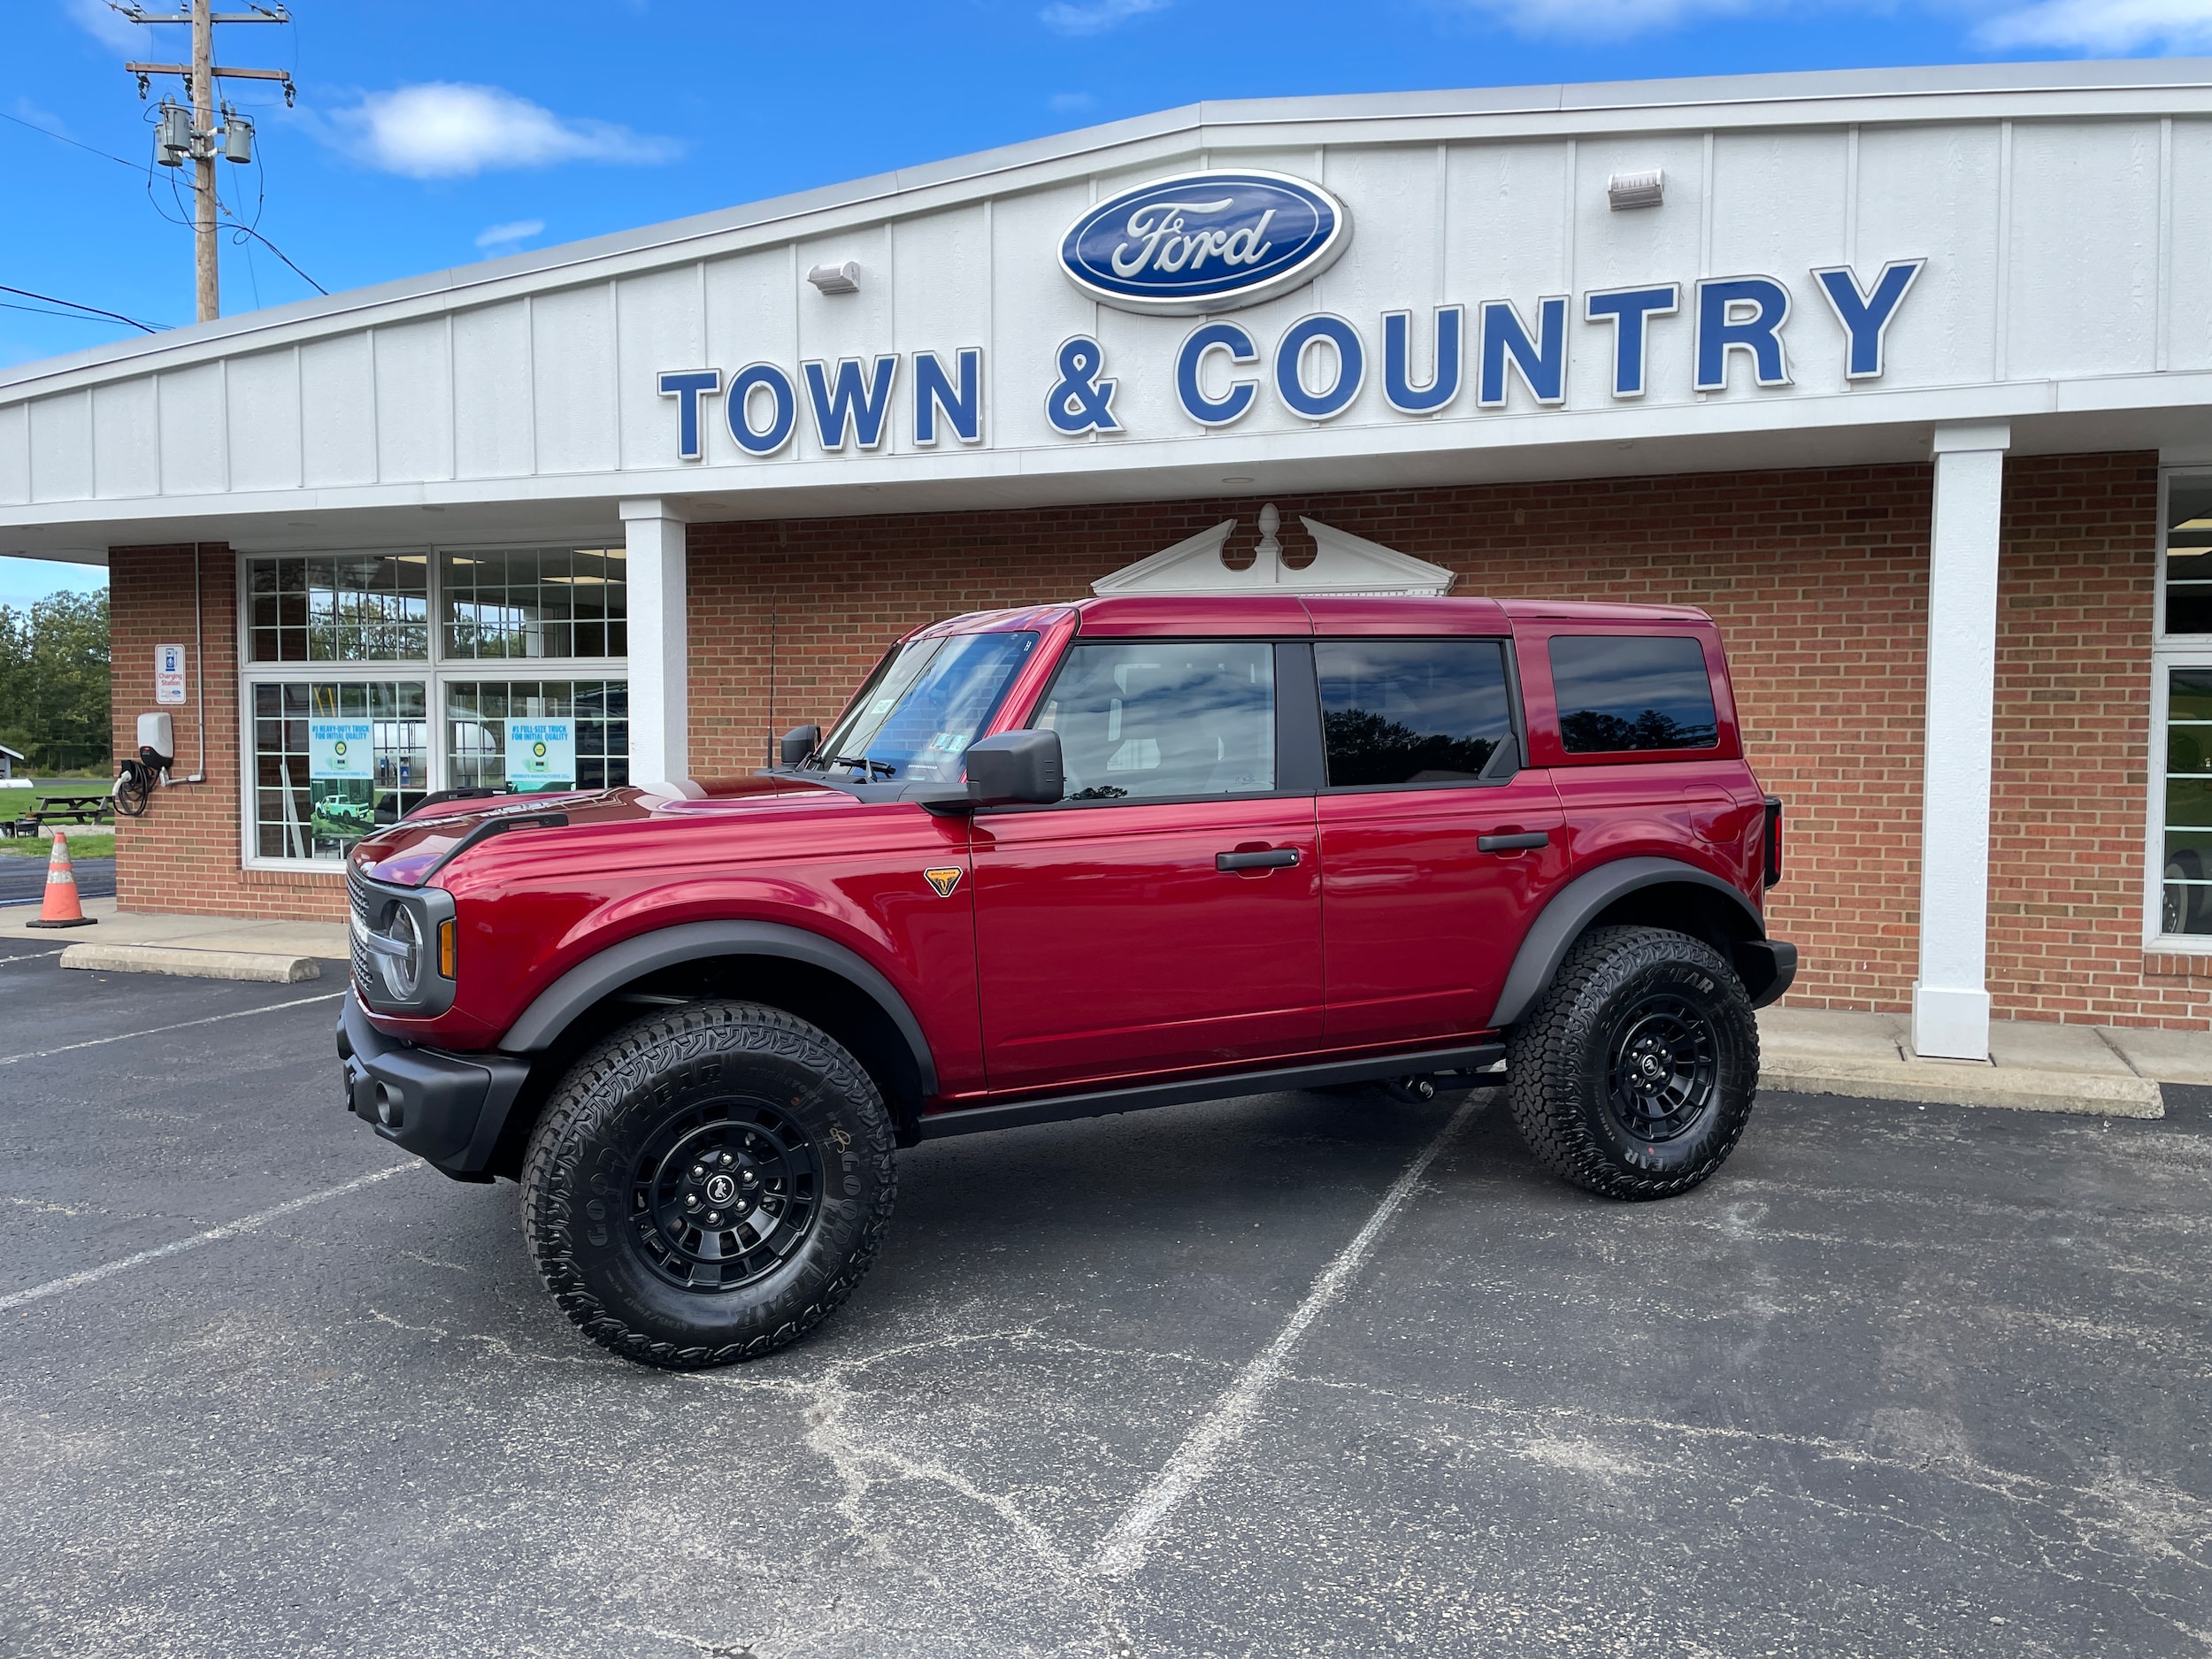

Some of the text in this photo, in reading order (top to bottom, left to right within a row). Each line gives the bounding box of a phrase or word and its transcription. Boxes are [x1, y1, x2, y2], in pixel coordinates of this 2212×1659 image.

[1111, 197, 1278, 278] Ford
[657, 257, 1928, 461] TOWN & COUNTRY
[545, 733, 568, 741] QUALITY
